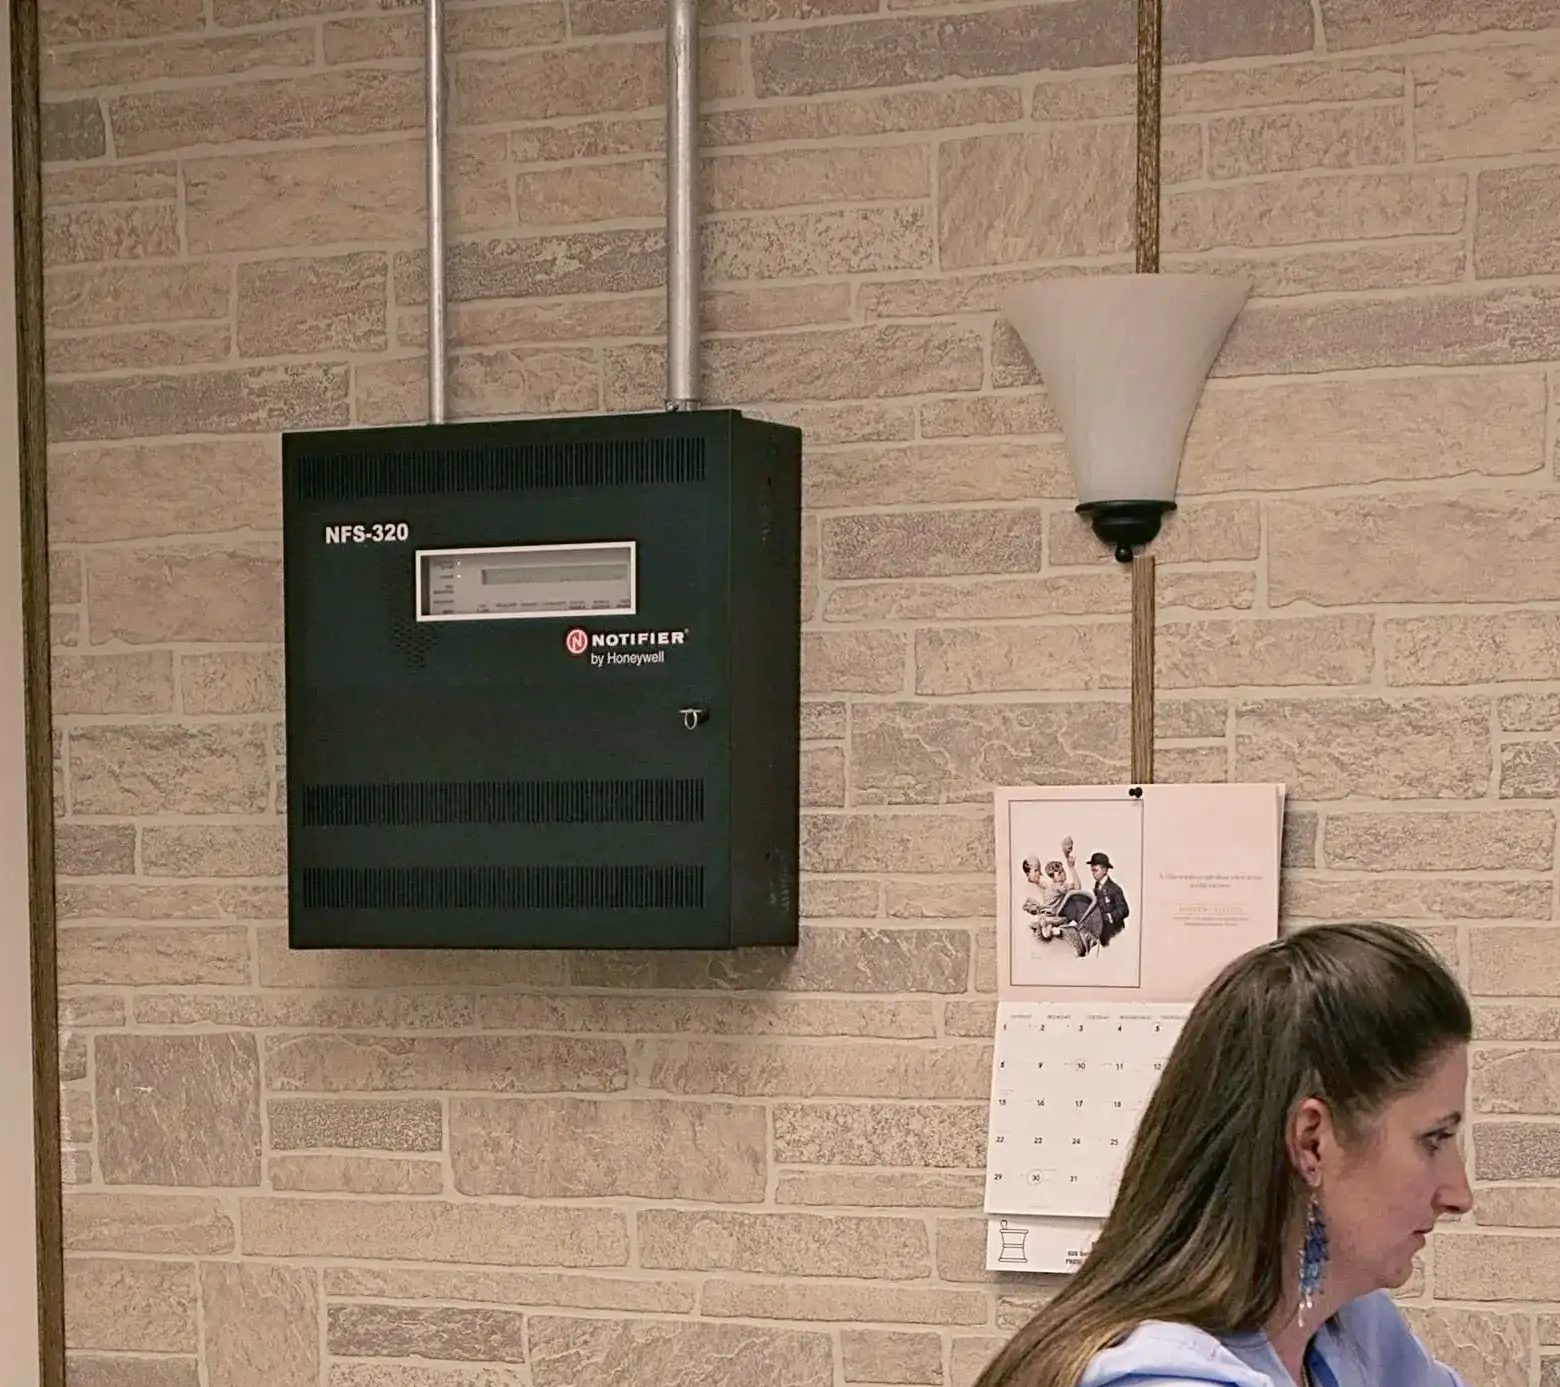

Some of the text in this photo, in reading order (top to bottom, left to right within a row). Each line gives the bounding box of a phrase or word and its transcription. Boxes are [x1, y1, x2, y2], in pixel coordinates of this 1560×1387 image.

[325, 522, 409, 544] NFS-320
[591, 631, 685, 647] NOTIFIER
[590, 650, 665, 668] by Honeywell
[1032, 1174, 1041, 1182] 30
